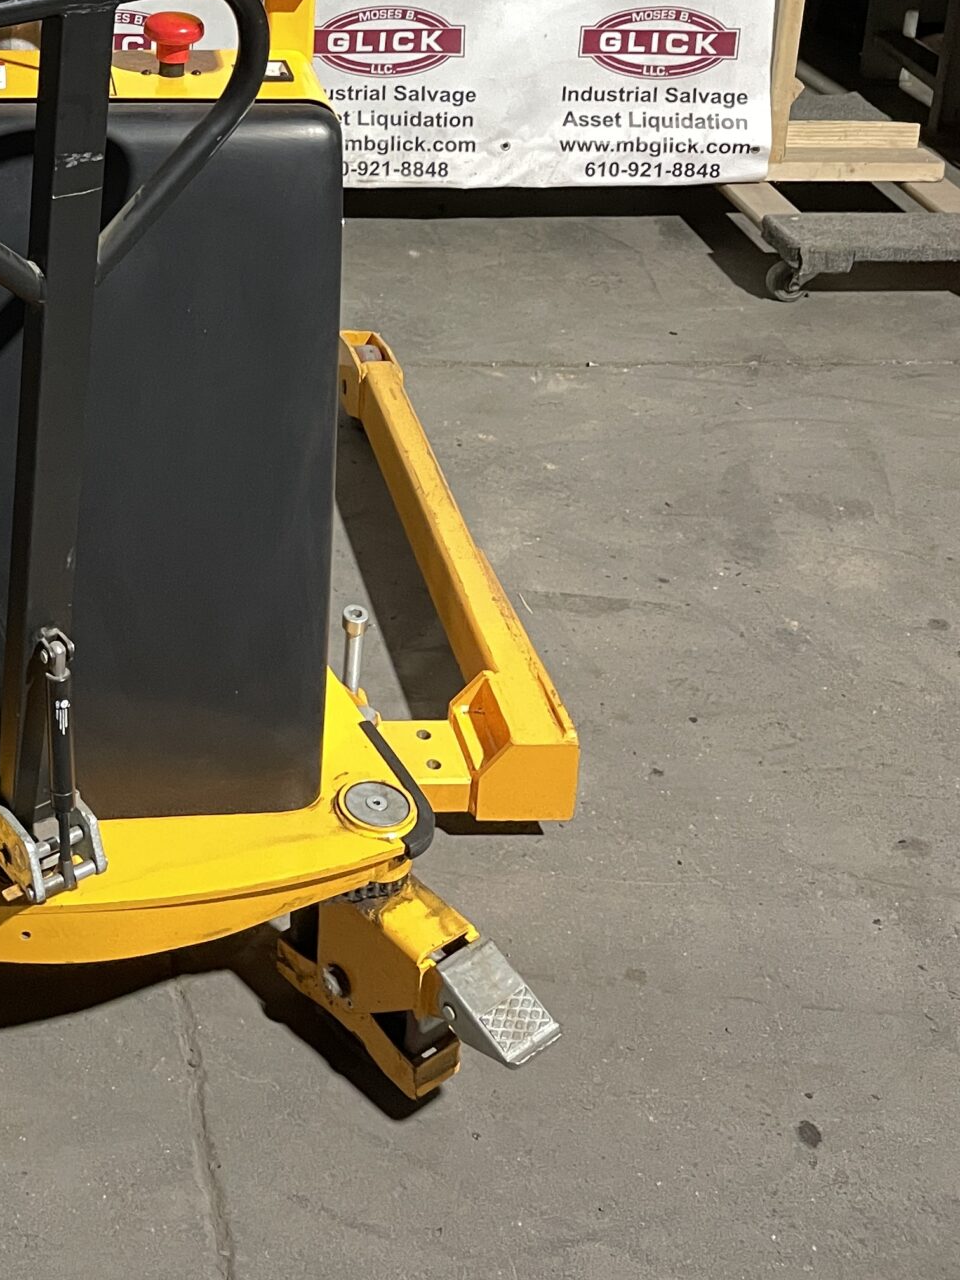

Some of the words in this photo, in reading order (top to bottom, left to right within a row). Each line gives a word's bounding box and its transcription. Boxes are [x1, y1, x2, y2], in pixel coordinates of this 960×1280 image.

[356, 9, 400, 21] MOSES
[630, 10, 674, 22] MOSES
[326, 31, 442, 52] GLICK
[599, 32, 716, 54] GLICK
[371, 65, 396, 74] LLC.
[644, 66, 669, 75] LLC.
[394, 86, 476, 106] Salvage
[562, 86, 657, 102] Industrial
[665, 88, 747, 108] Salvage
[358, 110, 473, 130] Liquidation
[563, 111, 621, 127] Asset
[629, 112, 747, 131] Liquidation
[560, 137, 752, 157] www.mbglick.com
[585, 162, 720, 178] 610-921-8848
